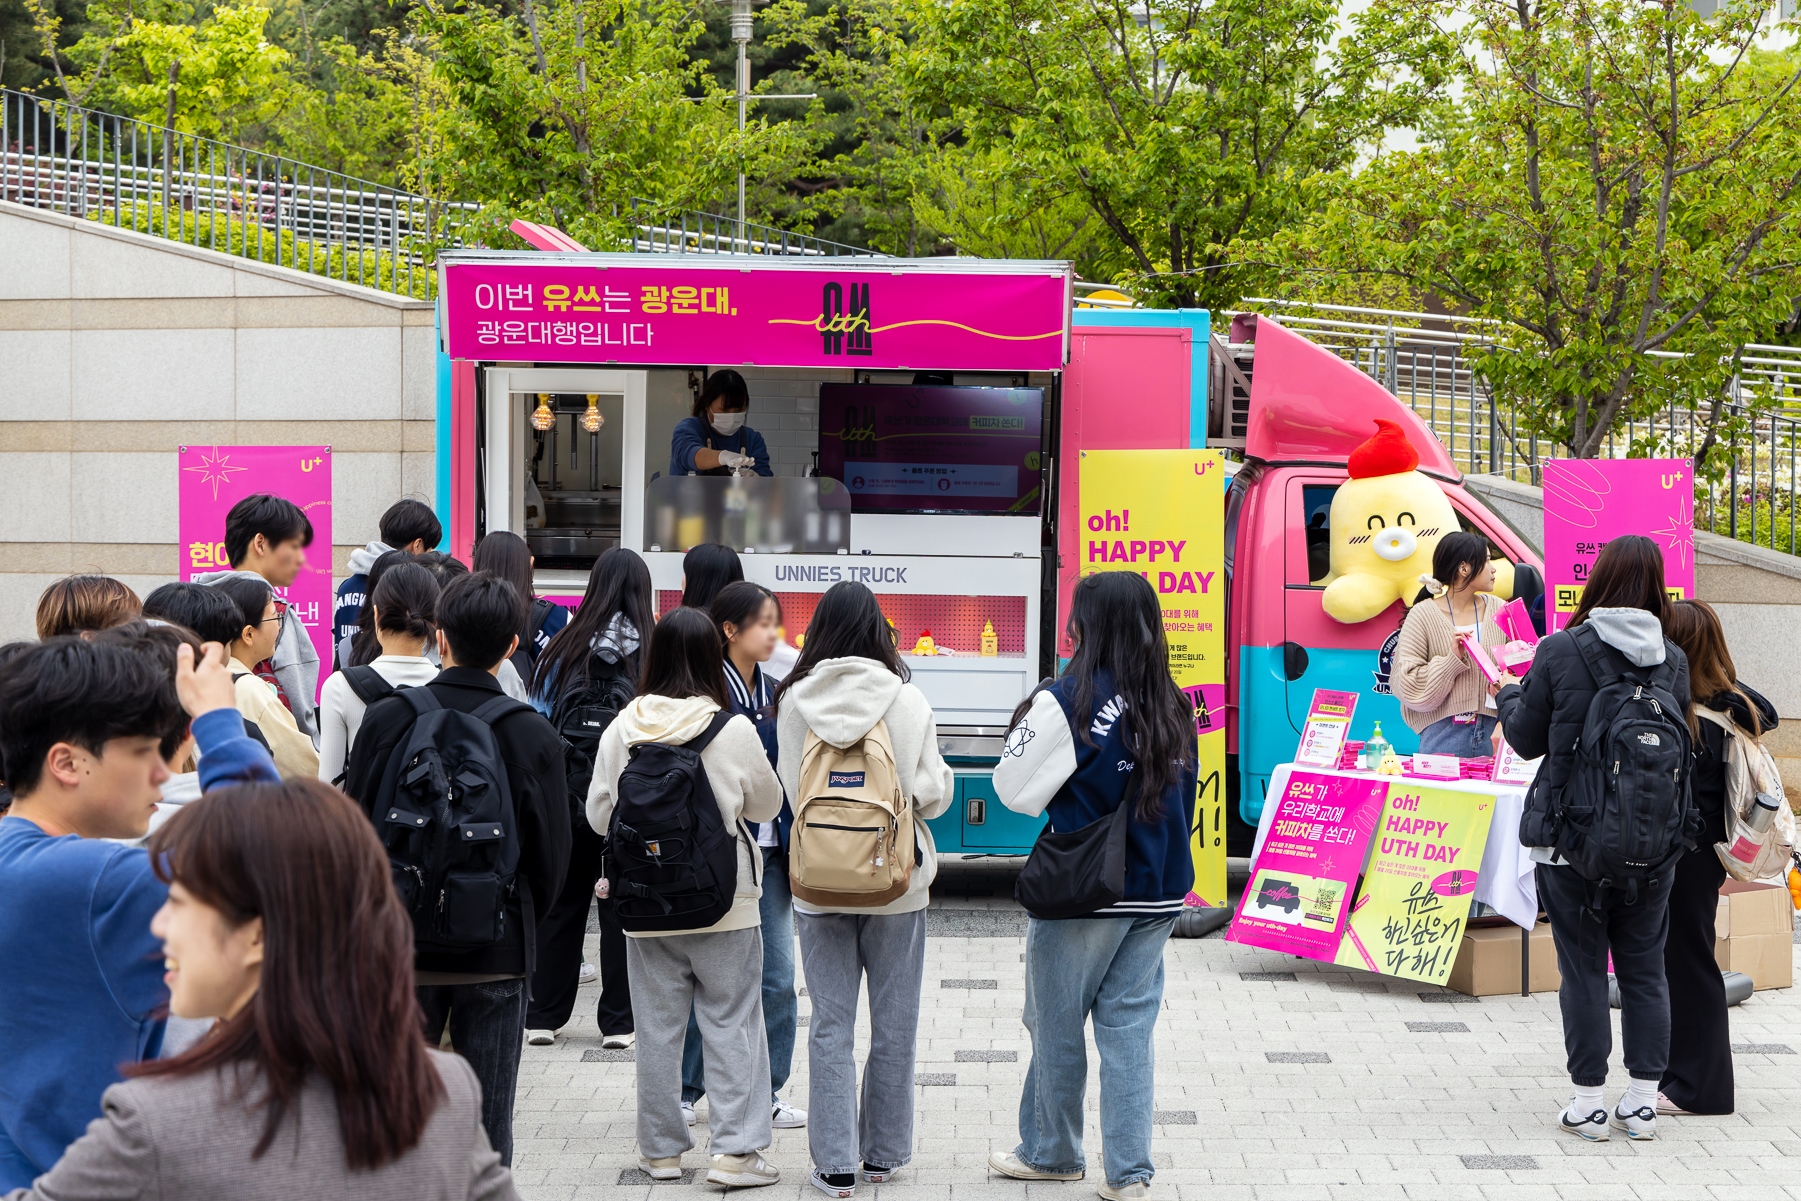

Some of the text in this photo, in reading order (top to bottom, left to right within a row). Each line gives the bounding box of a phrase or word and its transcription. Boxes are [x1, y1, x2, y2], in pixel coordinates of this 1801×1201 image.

[475, 283, 738, 316] 이번 유쓰는 광운대,
[476, 320, 654, 346] 광운대행입니다
[972, 418, 1000, 428] 커피차
[1001, 418, 1023, 429] 쏜다!
[1088, 510, 1129, 532] oh!
[1089, 540, 1186, 562] HAPPY
[1576, 542, 1596, 554] 유쓰
[776, 566, 908, 584] UNNIES TRUCK
[1158, 572, 1215, 593] DAY
[1161, 610, 1198, 618] 0대를 위해
[1164, 623, 1212, 632] 찾아오는 혜택
[1282, 801, 1345, 823] 우리학교에
[1392, 794, 1420, 811] oh!
[1275, 820, 1356, 845] 커피차를 쏜다!
[1386, 815, 1449, 838] HAPPY
[1381, 837, 1460, 863] UTH DAY
[1266, 886, 1292, 901] coffee
[1266, 923, 1287, 932] uth-day
